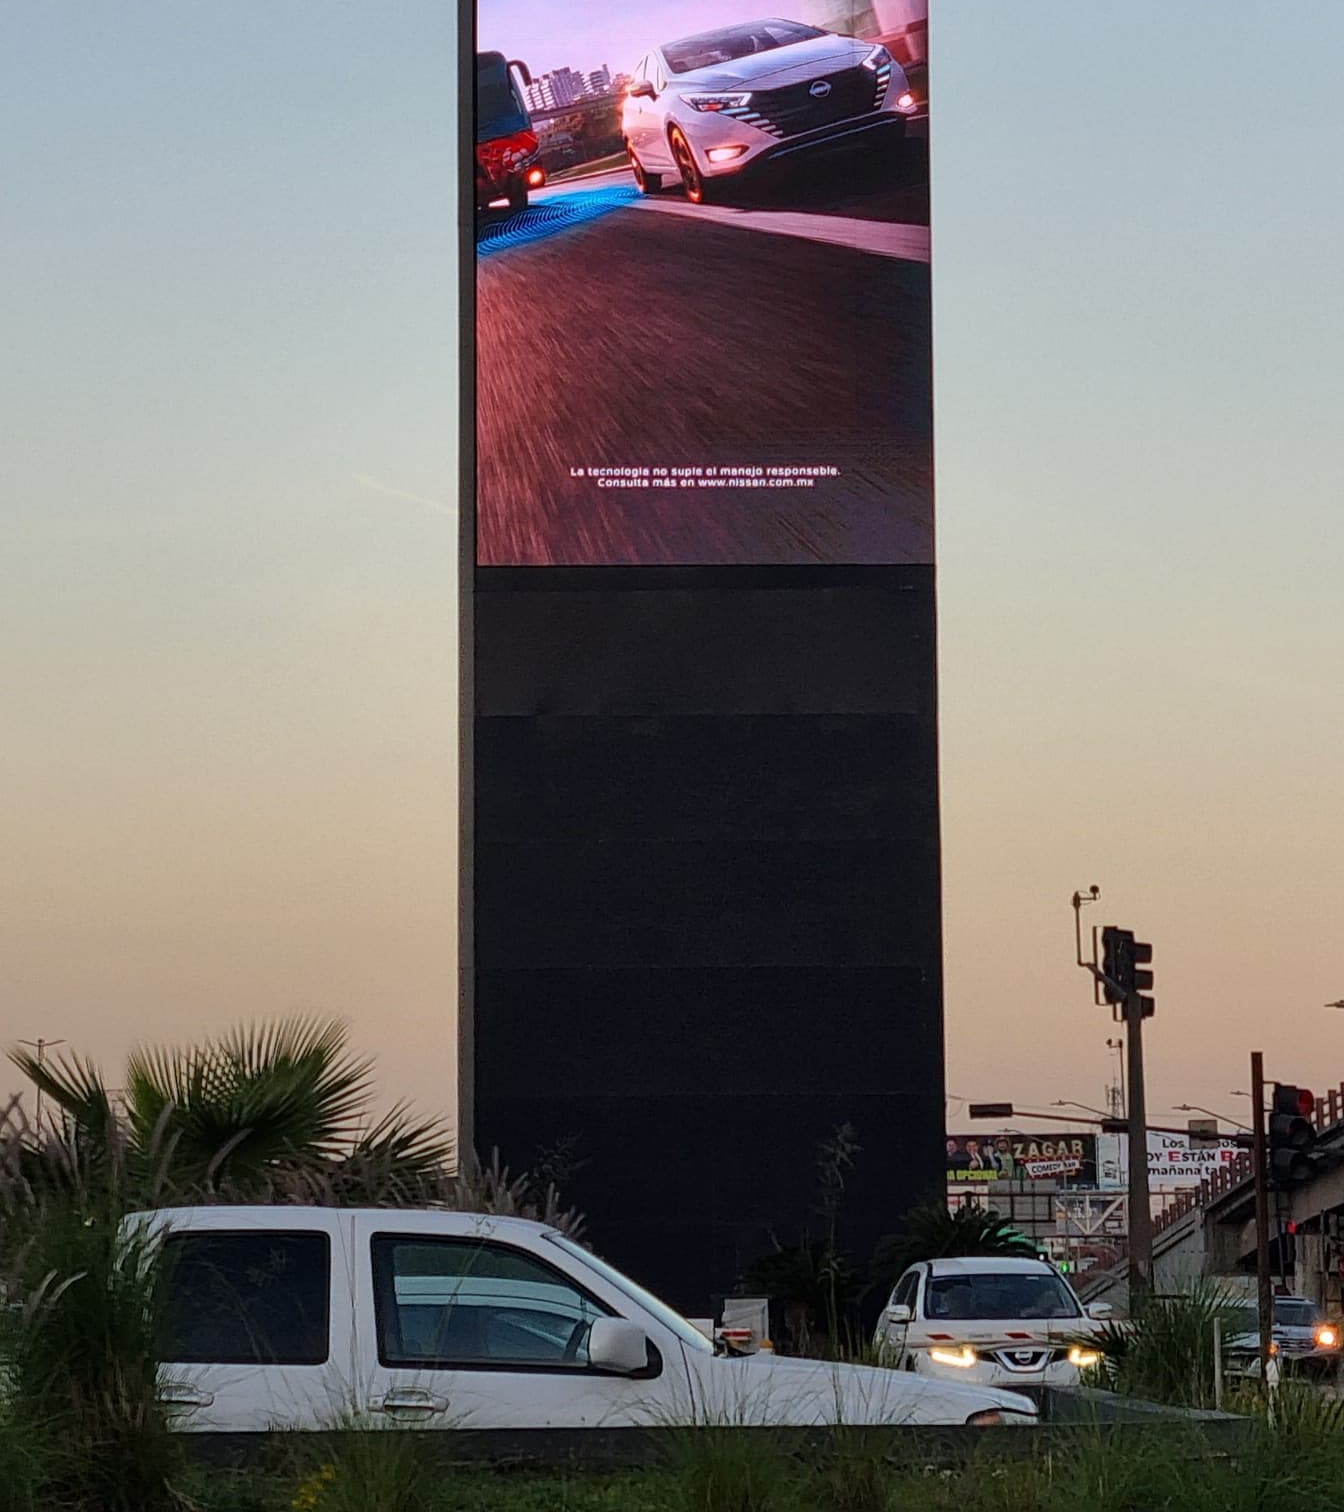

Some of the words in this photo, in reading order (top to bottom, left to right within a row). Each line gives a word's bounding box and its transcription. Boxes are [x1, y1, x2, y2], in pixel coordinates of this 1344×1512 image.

[570, 466, 585, 477] La
[652, 467, 668, 477] no
[671, 466, 703, 478] suple
[705, 465, 717, 476] el
[719, 465, 763, 477] manejo
[597, 477, 649, 487] Consulta
[652, 477, 677, 487] más
[680, 478, 695, 487] en
[697, 477, 814, 487] www.nissan.com.mx
[1013, 1139, 1084, 1159] ZAGAR
